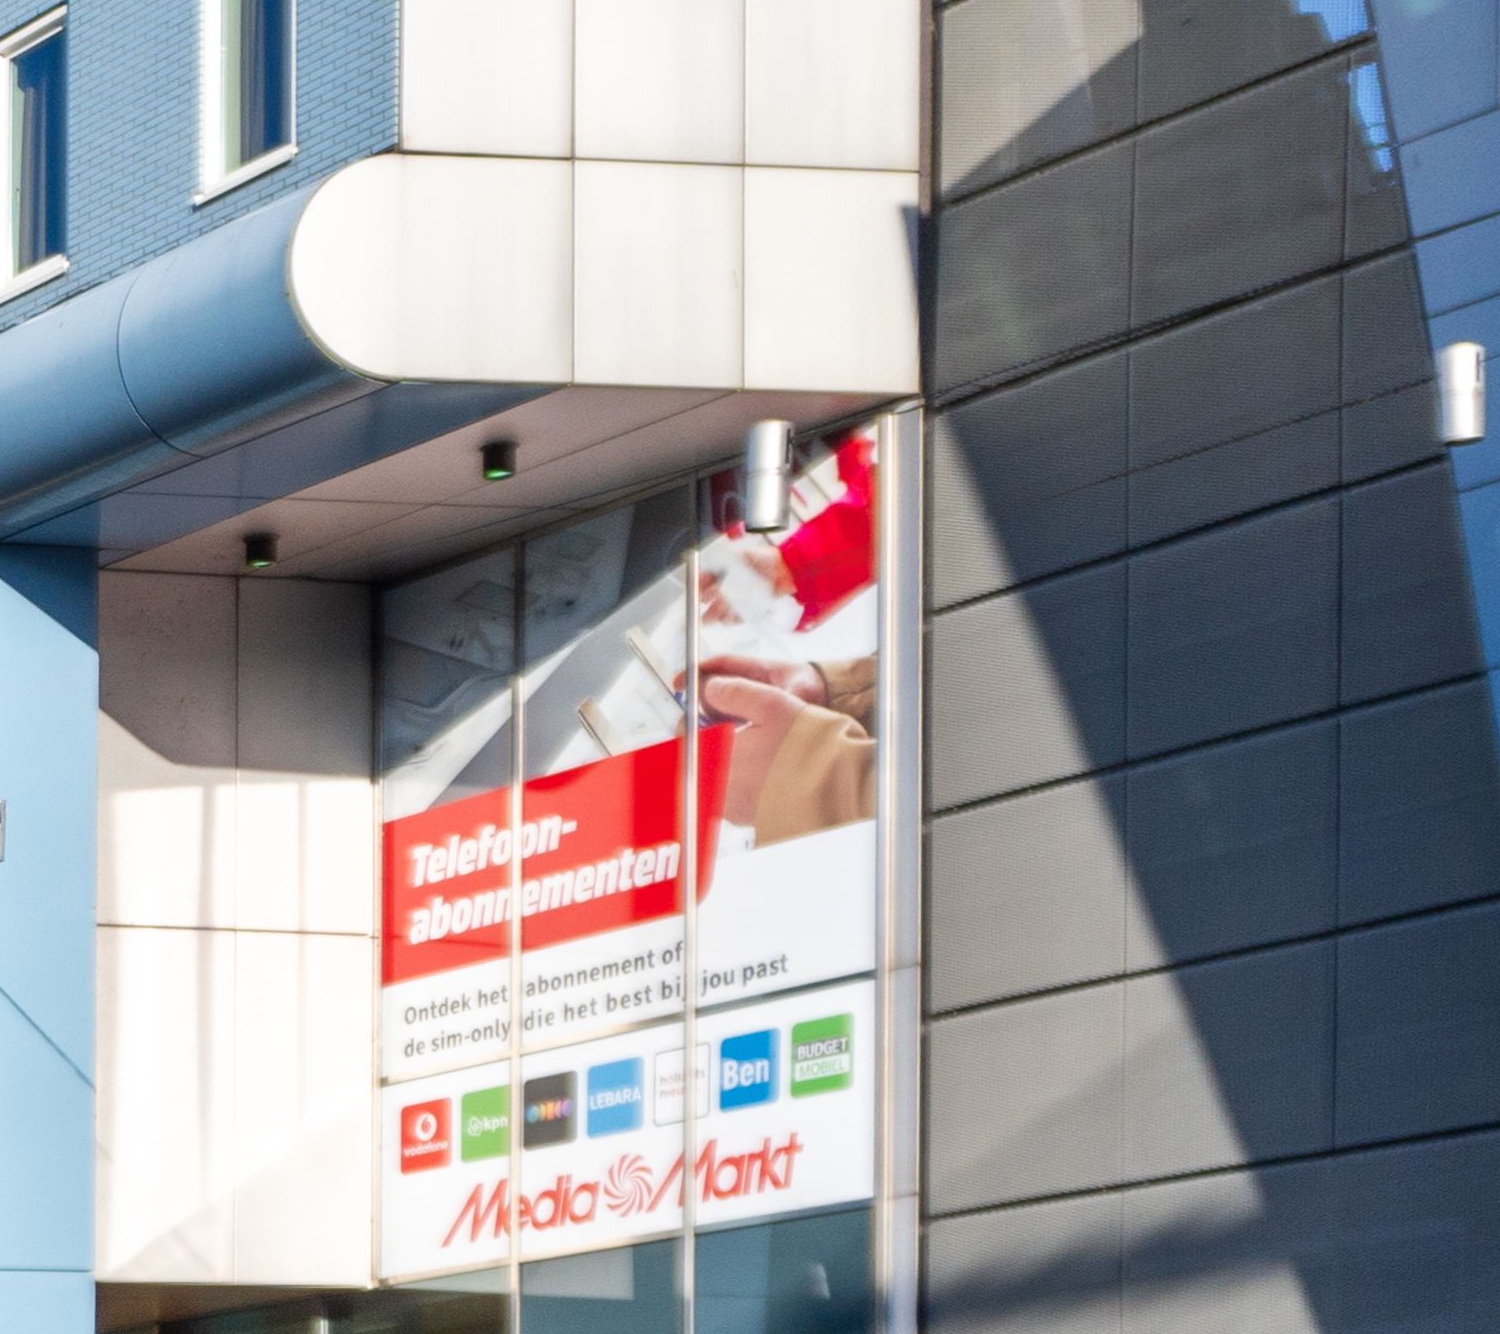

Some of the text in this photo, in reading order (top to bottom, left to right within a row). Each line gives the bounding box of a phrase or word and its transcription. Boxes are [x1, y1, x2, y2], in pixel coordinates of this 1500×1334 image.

[412, 815, 578, 889] Telefoon-
[409, 842, 681, 946] abonnementen
[404, 940, 684, 1025] Ontdek het abonnement of
[404, 1037, 425, 1058] de
[431, 1018, 511, 1053] sim-only
[523, 1009, 555, 1031] die
[563, 998, 597, 1024] het
[606, 985, 652, 1013] best
[701, 969, 735, 997] jou
[742, 954, 789, 986] past
[797, 1037, 849, 1060] BUDGET
[723, 1058, 770, 1091] Ben
[800, 1058, 847, 1078] MOBIEL
[590, 1086, 642, 1111] LEBARA
[484, 1115, 508, 1134] kpn
[403, 1141, 449, 1158] vodafone
[442, 1130, 804, 1248] Media Markt
